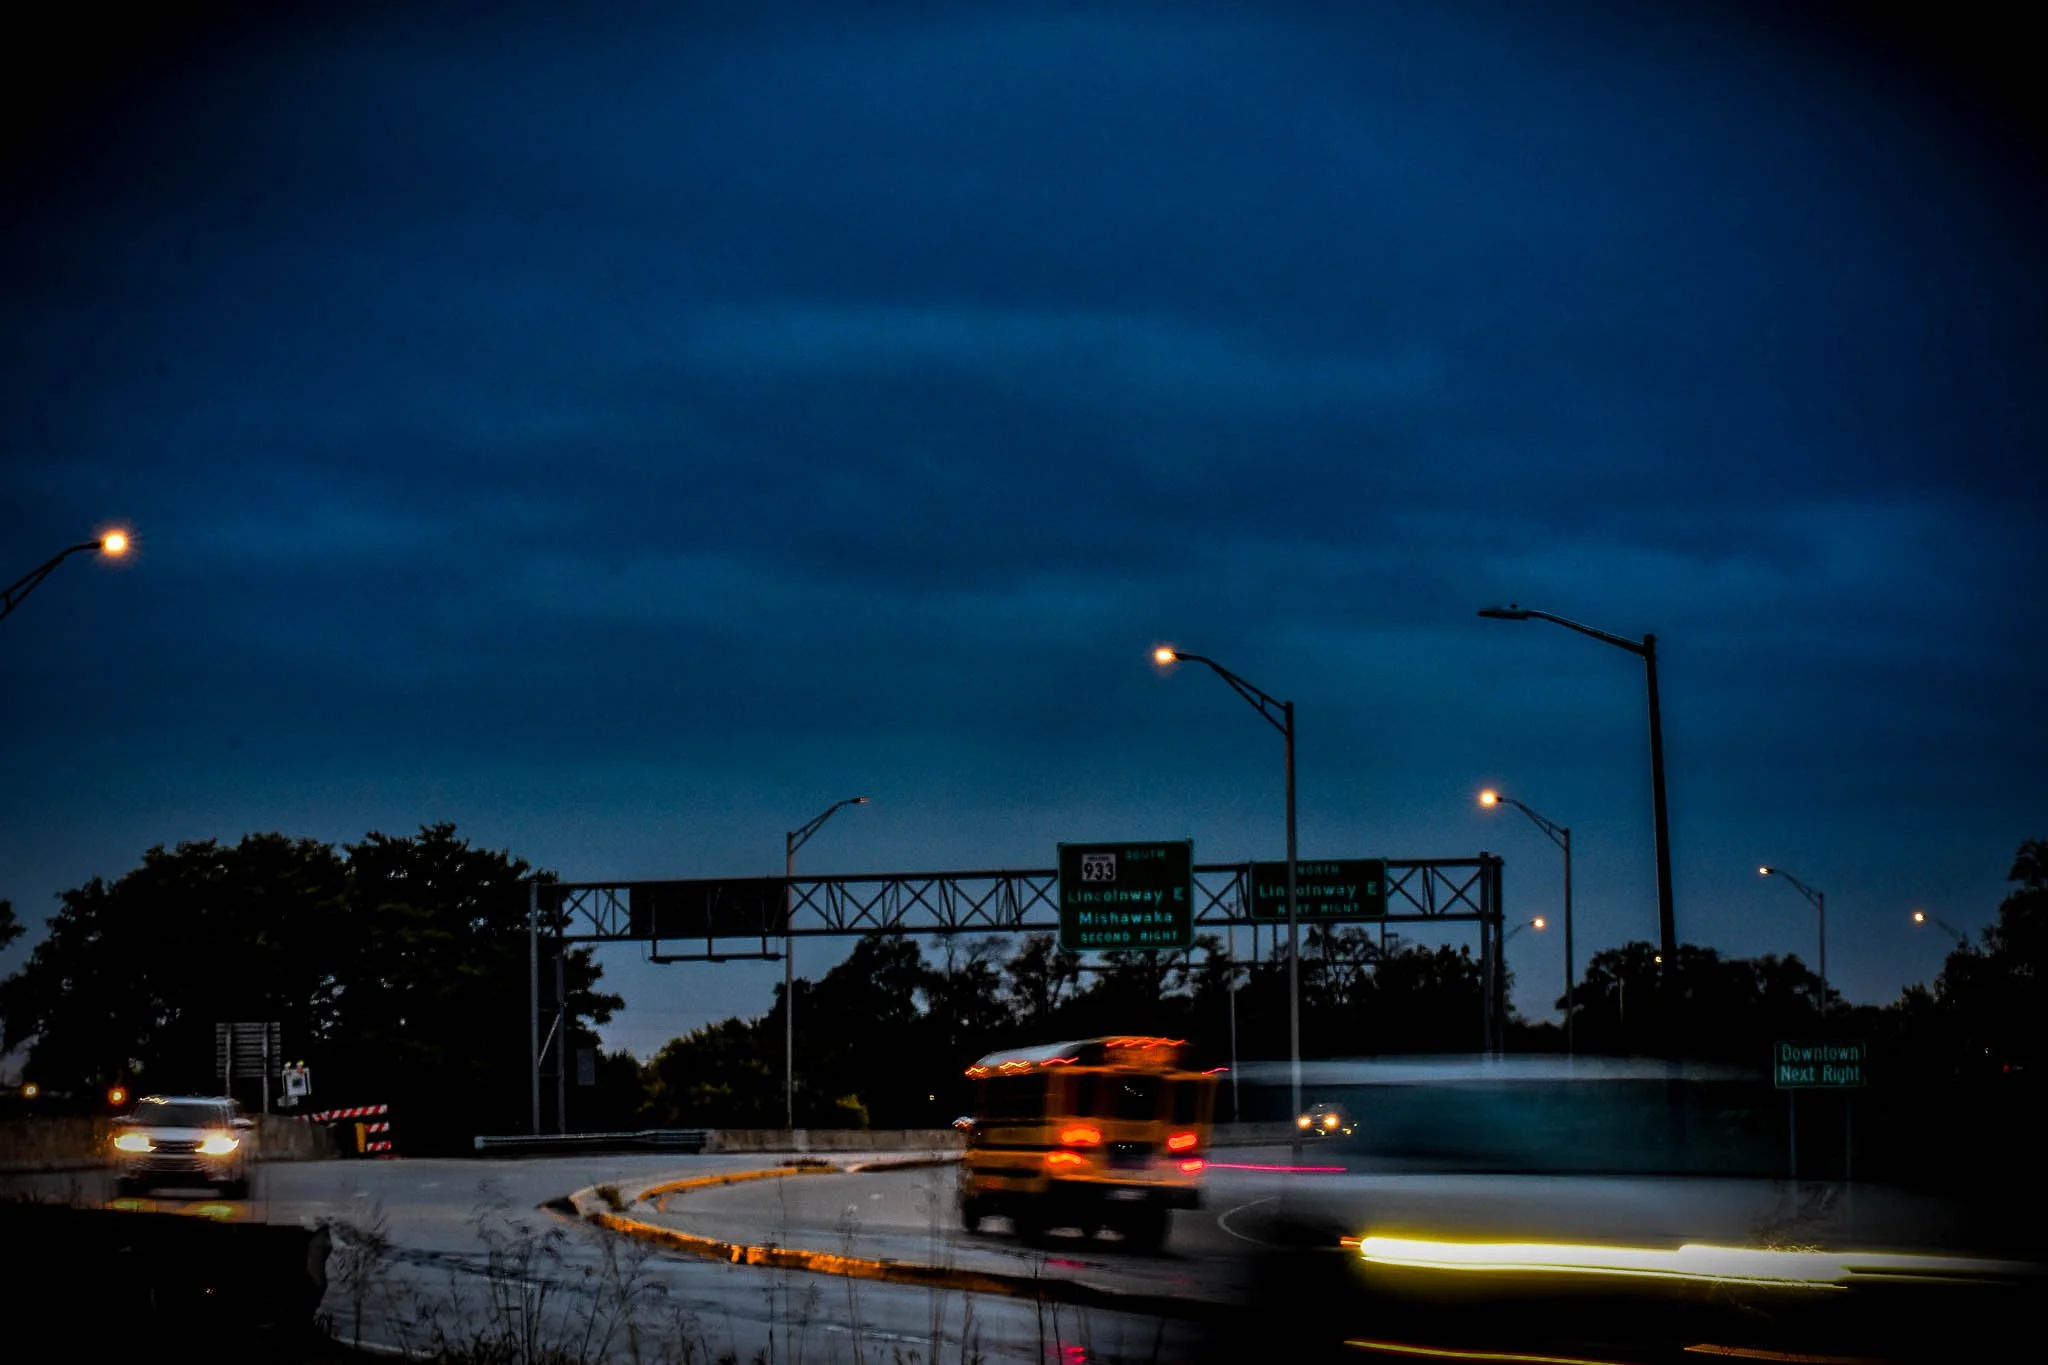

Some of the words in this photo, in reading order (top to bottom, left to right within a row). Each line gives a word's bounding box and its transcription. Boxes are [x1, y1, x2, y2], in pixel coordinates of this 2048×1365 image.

[1125, 848, 1167, 860] SOUTH
[1084, 862, 1114, 881] 933
[1296, 864, 1340, 875] NORTH
[1067, 887, 1165, 906] Lincolnway
[1172, 886, 1185, 902] E
[1258, 882, 1357, 900] Linolnway
[1367, 880, 1378, 896] E
[1277, 903, 1311, 915] NT
[1320, 902, 1360, 913] RIGHT
[1078, 909, 1174, 925] Mishawaka
[1080, 930, 1131, 943] SECOND
[1140, 928, 1179, 942] RIGHT
[1781, 1044, 1859, 1061] Downtown
[1780, 1065, 1816, 1081] Next
[1822, 1064, 1861, 1083] Right
